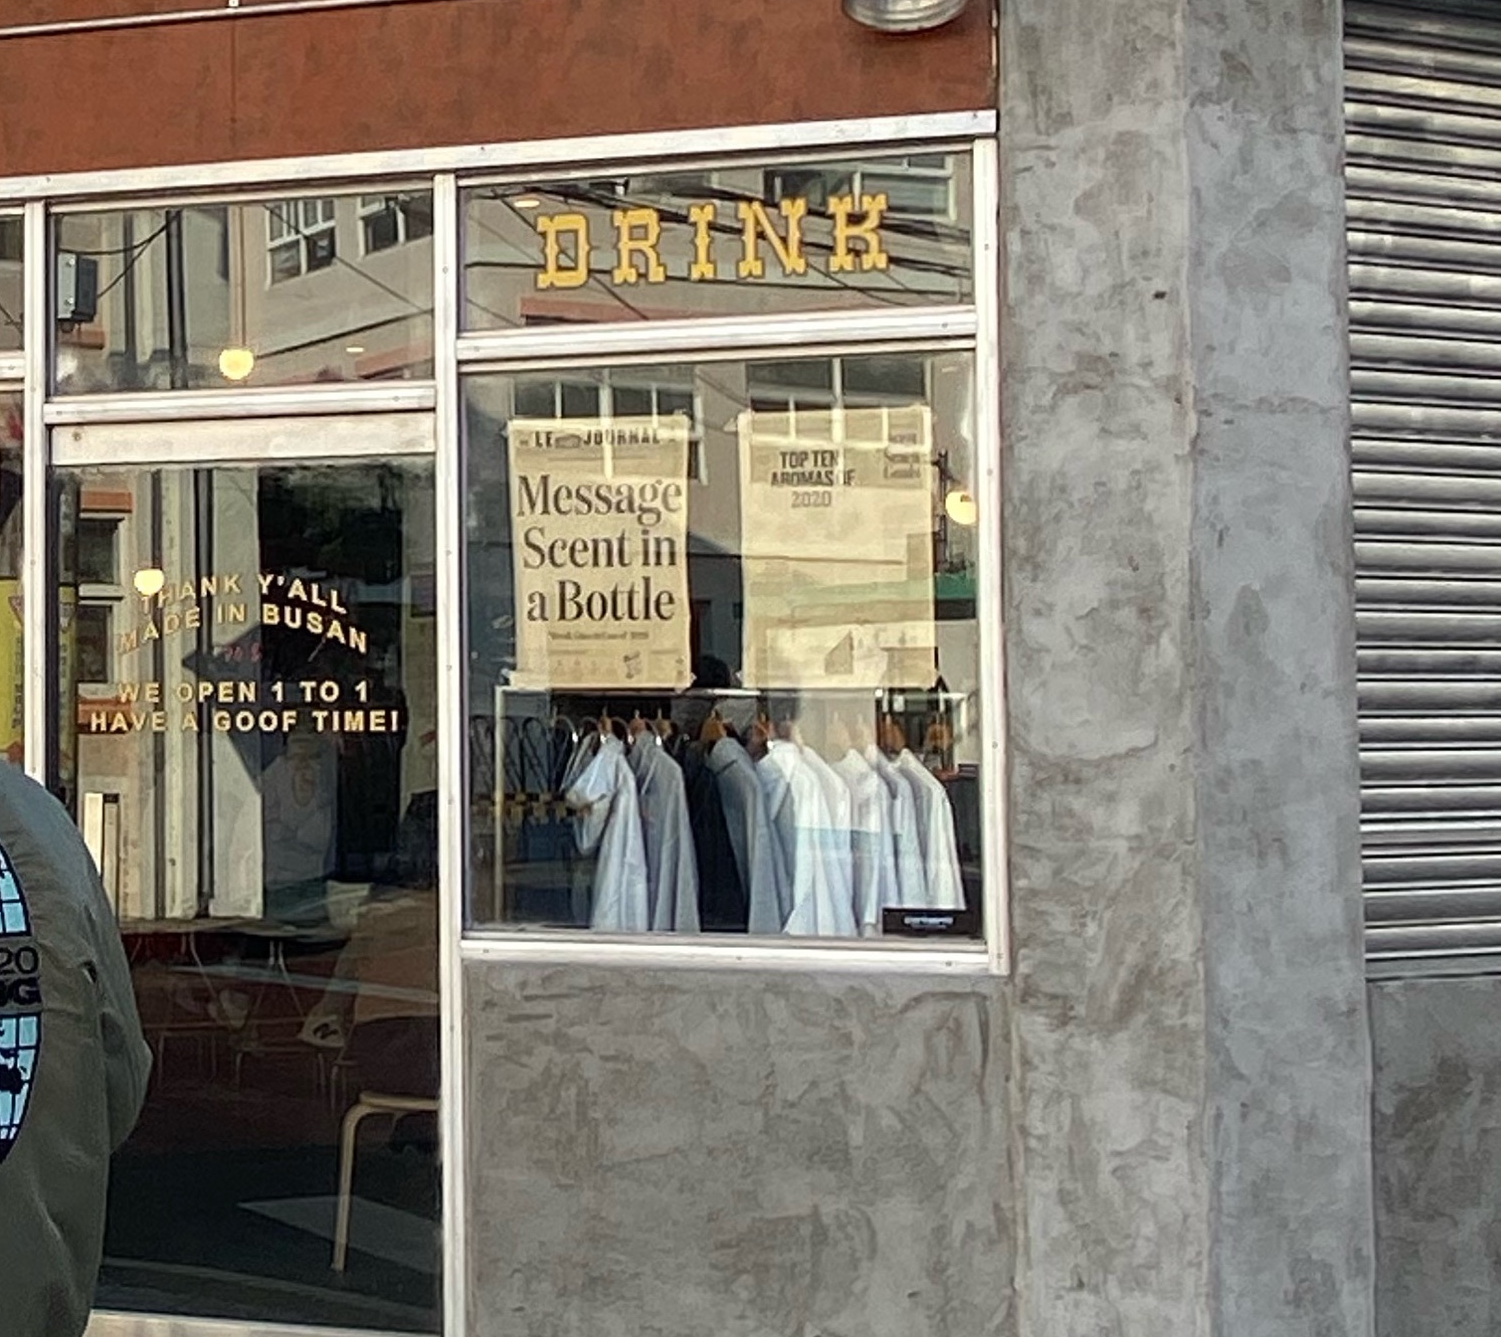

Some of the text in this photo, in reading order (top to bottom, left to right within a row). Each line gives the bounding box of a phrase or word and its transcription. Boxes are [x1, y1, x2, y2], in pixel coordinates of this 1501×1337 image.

[535, 192, 891, 291] DRINK
[770, 469, 834, 488] AROMAS
[779, 449, 840, 470] TOP TEN
[517, 474, 684, 528] Message
[790, 490, 833, 509] 2020
[523, 526, 678, 570] Scent in
[257, 572, 348, 616] Y'ALL
[526, 575, 677, 623] a Bottle
[118, 606, 202, 654] MADE
[216, 602, 247, 626] IN
[262, 602, 369, 655] BUSAN
[118, 680, 369, 703] WE OPEN 1 TO 1
[90, 709, 400, 733] HAVE A GOOF TIME!
